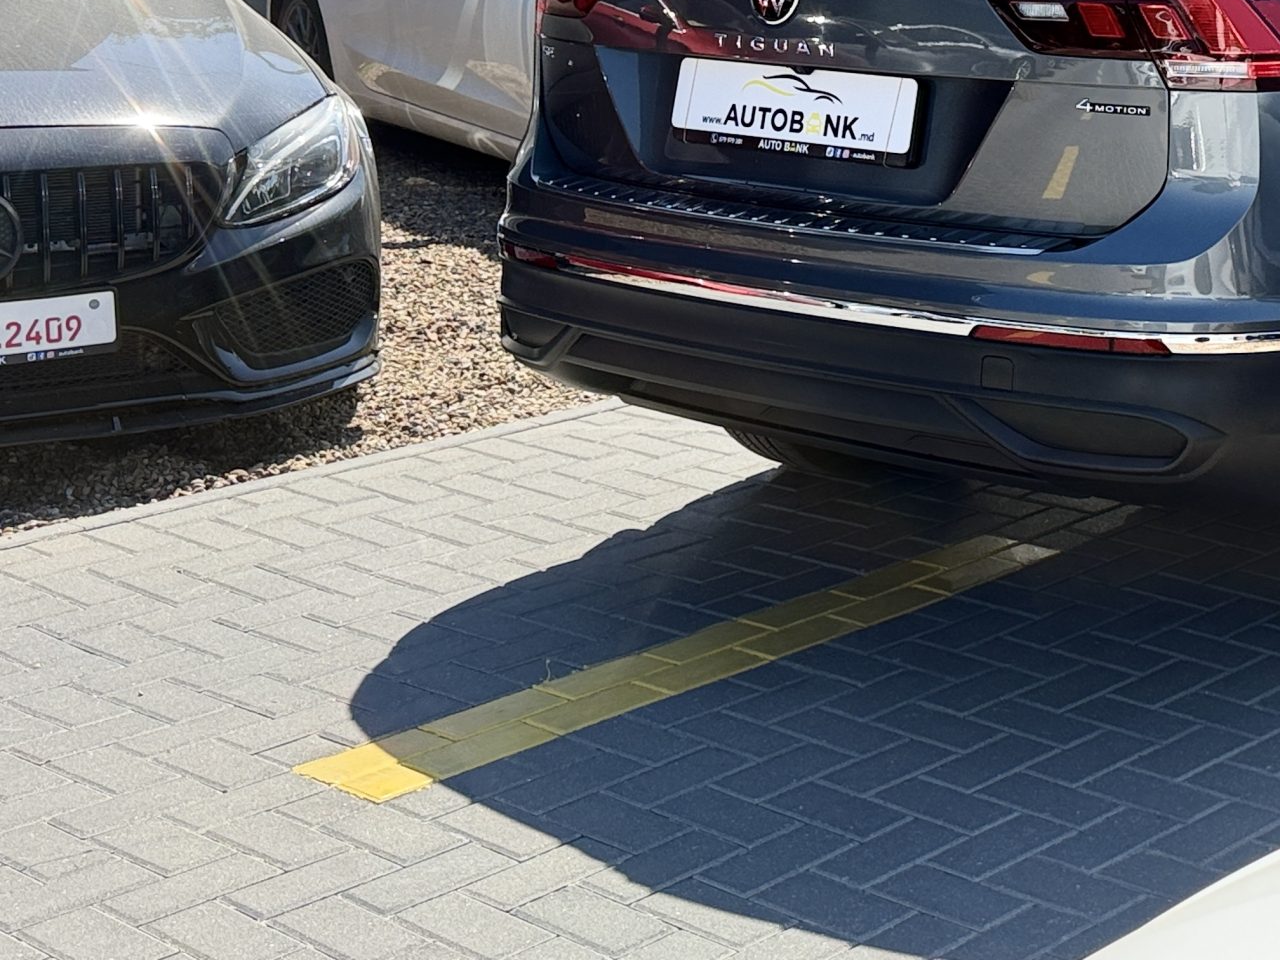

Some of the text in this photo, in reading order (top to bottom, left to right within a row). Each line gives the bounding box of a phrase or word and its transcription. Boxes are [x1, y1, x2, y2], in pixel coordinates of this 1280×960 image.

[714, 33, 836, 58] TIGUAN
[758, 139, 782, 151] AUTO
[0, 315, 82, 349] 2409
